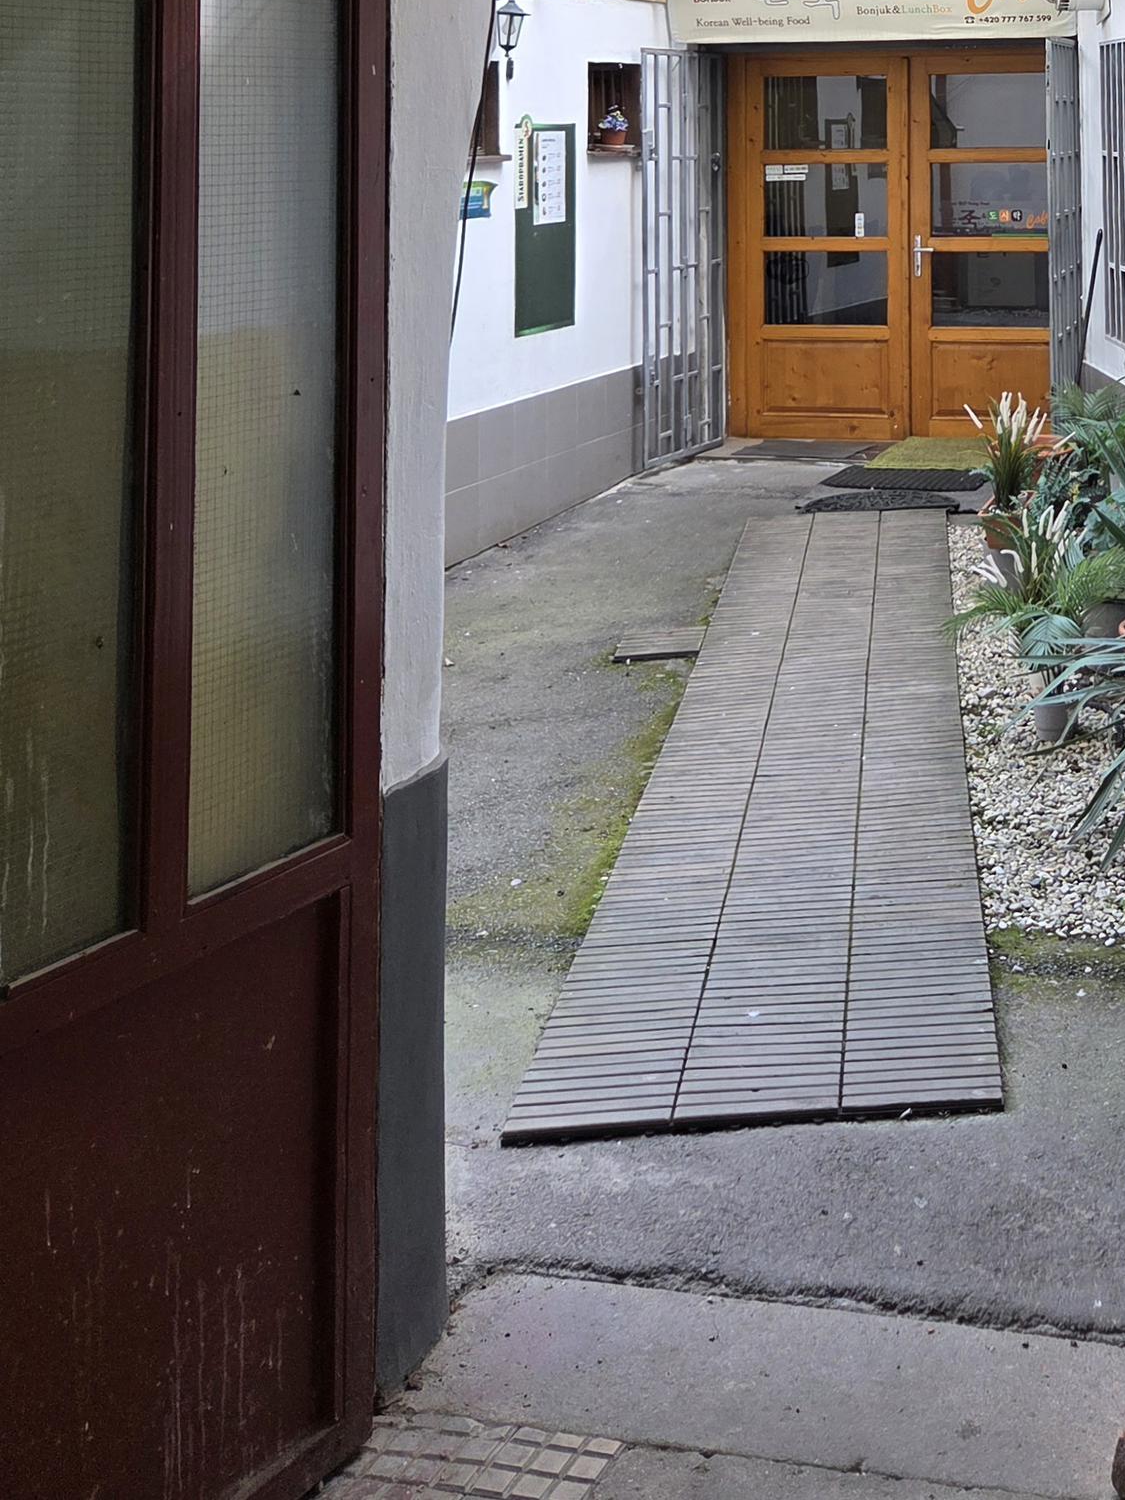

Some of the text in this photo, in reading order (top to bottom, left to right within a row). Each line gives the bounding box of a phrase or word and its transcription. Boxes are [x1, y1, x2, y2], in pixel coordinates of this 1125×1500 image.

[856, 3, 952, 16] Bonjuk&LunchBox
[696, 15, 810, 28] Korean Well-being Food
[979, 14, 1051, 23] +420 777 767 599
